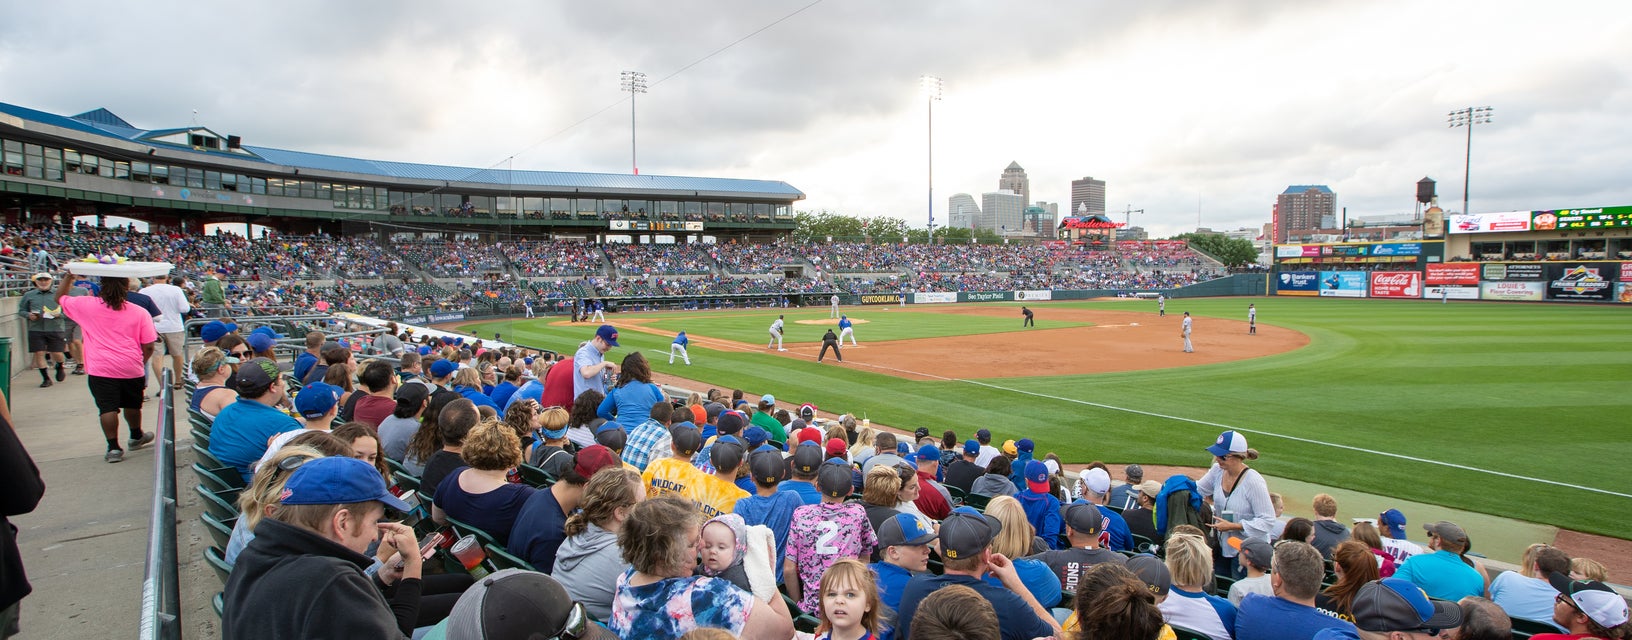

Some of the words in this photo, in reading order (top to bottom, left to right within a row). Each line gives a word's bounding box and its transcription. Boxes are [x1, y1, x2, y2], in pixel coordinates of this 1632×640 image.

[1062, 218, 1126, 229] Budweiser
[652, 478, 686, 492] WILDCAT
[816, 521, 839, 554] 2
